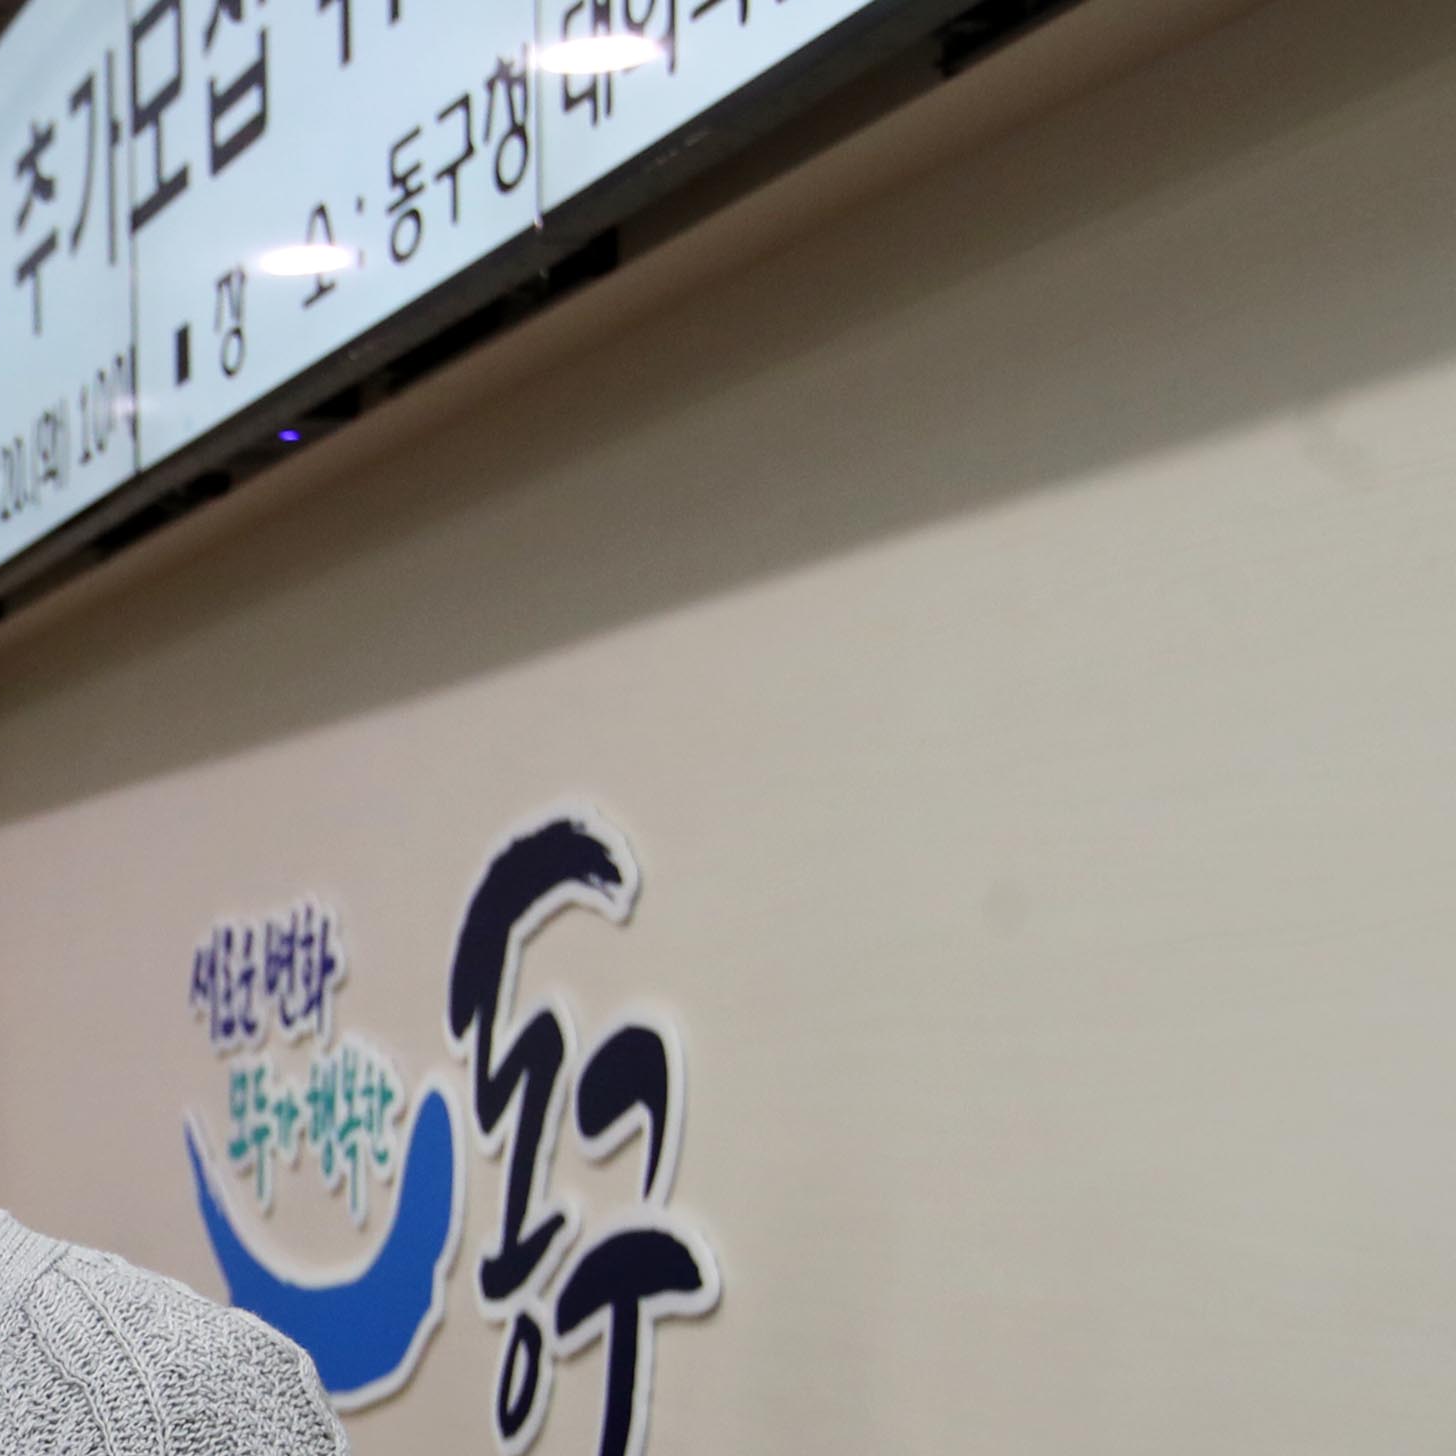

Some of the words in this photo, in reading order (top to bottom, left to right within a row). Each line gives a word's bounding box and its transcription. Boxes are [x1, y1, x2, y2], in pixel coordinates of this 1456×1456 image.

[16, 0, 268, 336] 추가모집
[387, 43, 530, 264] 동구청
[190, 926, 257, 1041] 새로운
[264, 904, 337, 1035] 변화
[229, 1064, 300, 1203] 모두가
[306, 1047, 395, 1214] 행복한
